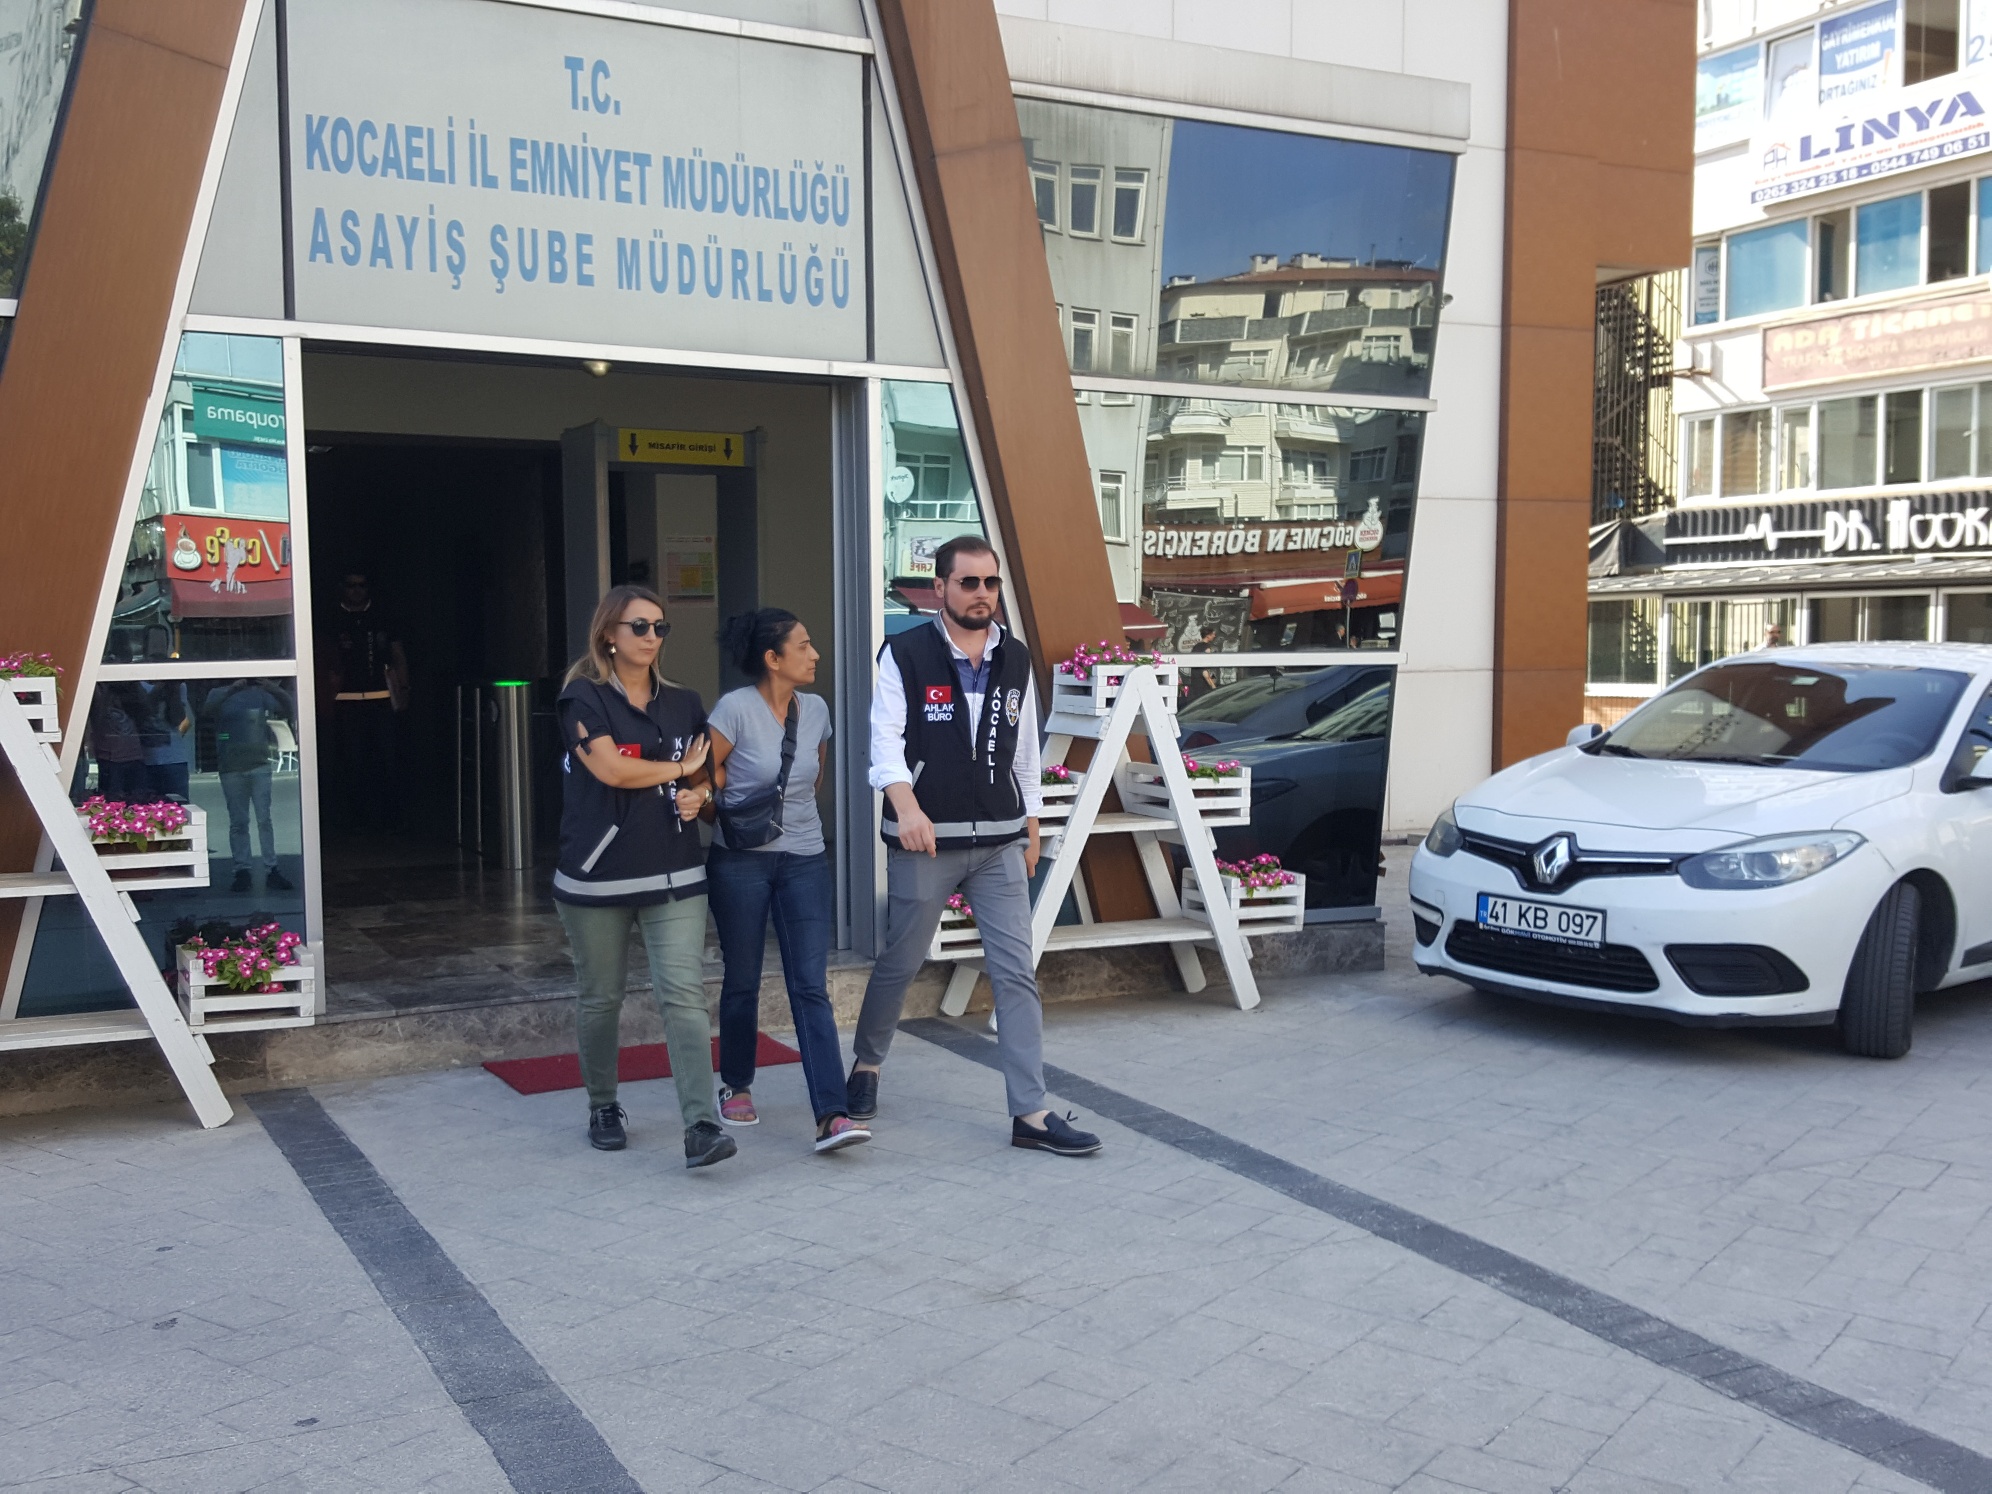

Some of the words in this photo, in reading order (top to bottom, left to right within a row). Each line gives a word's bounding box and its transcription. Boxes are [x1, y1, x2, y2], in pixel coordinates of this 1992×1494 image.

[1968, 35, 1992, 64] 2
[564, 55, 621, 116] T.C.
[305, 112, 456, 185] KOCAELİ
[468, 118, 499, 190] İL
[509, 132, 652, 206] EMNİYET
[662, 147, 850, 227] MÜDÜRLÜĞÜ
[1754, 185, 1788, 203] 0262
[1790, 177, 1817, 194] 324
[1819, 172, 1837, 188] 25
[1871, 155, 1907, 174] 0544
[1911, 146, 1940, 163] 749
[1943, 139, 1964, 155] 06
[1967, 133, 1987, 151] 51
[308, 203, 466, 290] ASAYİŞ
[490, 223, 595, 294] ŞUBE
[616, 229, 850, 309] MÜDÜRLÜĞÜ
[924, 703, 954, 712] AHLAK
[927, 712, 952, 721] BÜRO
[1489, 900, 1507, 924] 41
[1518, 904, 1549, 930] KB
[1558, 910, 1598, 937] 097
